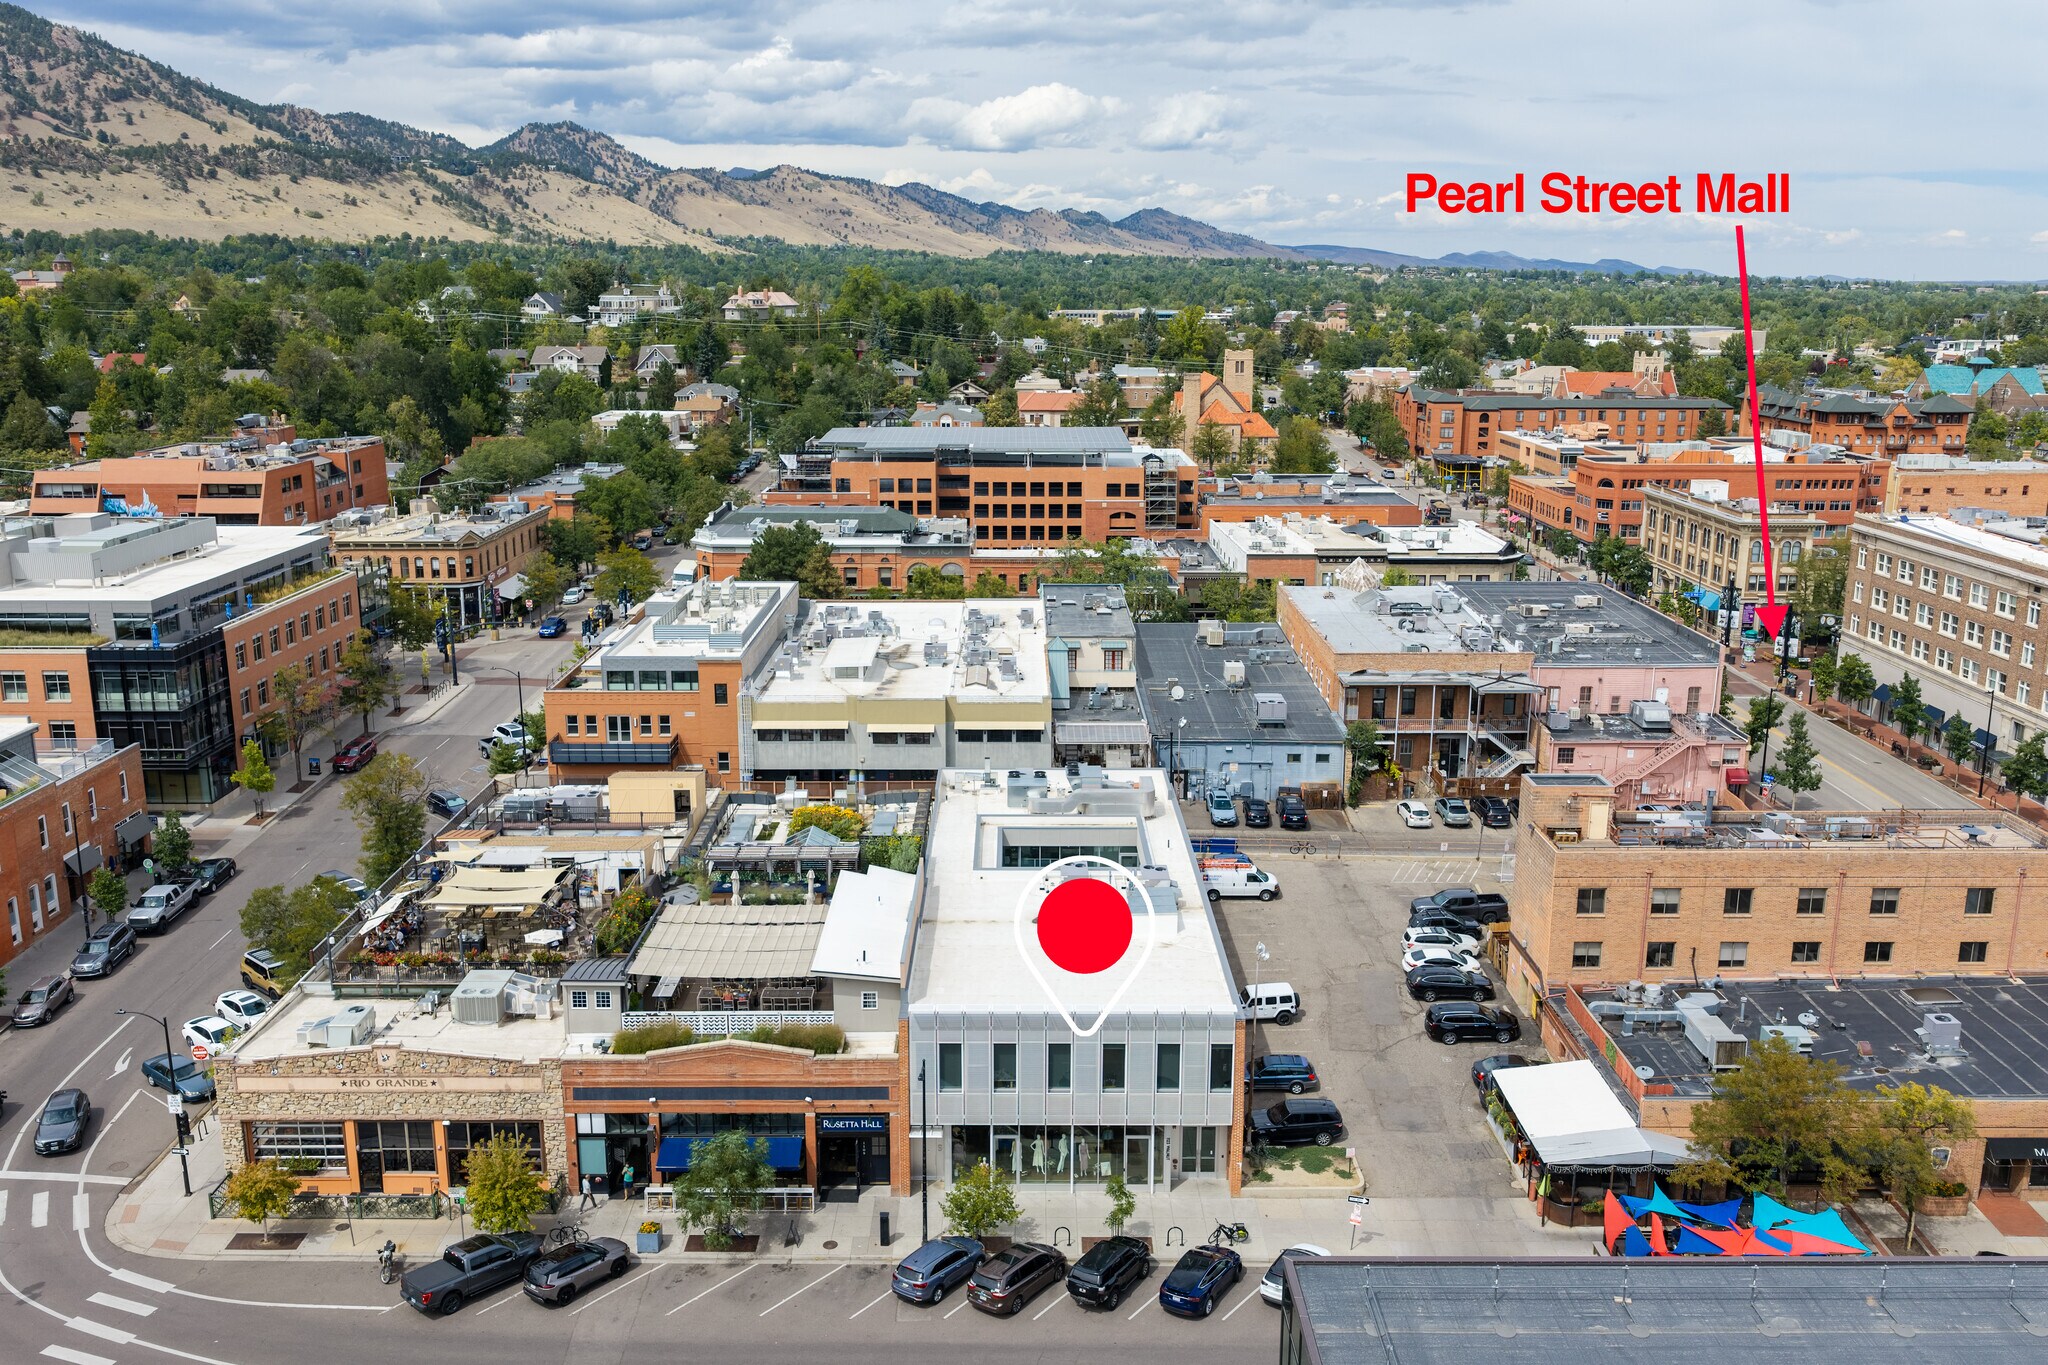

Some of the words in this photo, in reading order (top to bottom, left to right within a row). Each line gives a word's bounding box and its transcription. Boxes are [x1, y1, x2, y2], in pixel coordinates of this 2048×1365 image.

[350, 1079, 370, 1087] RIO
[376, 1079, 428, 1087] GRANDE
[823, 1119, 859, 1128] ROSETTA
[861, 1119, 882, 1128] HALL
[2034, 1148, 2048, 1157] M
